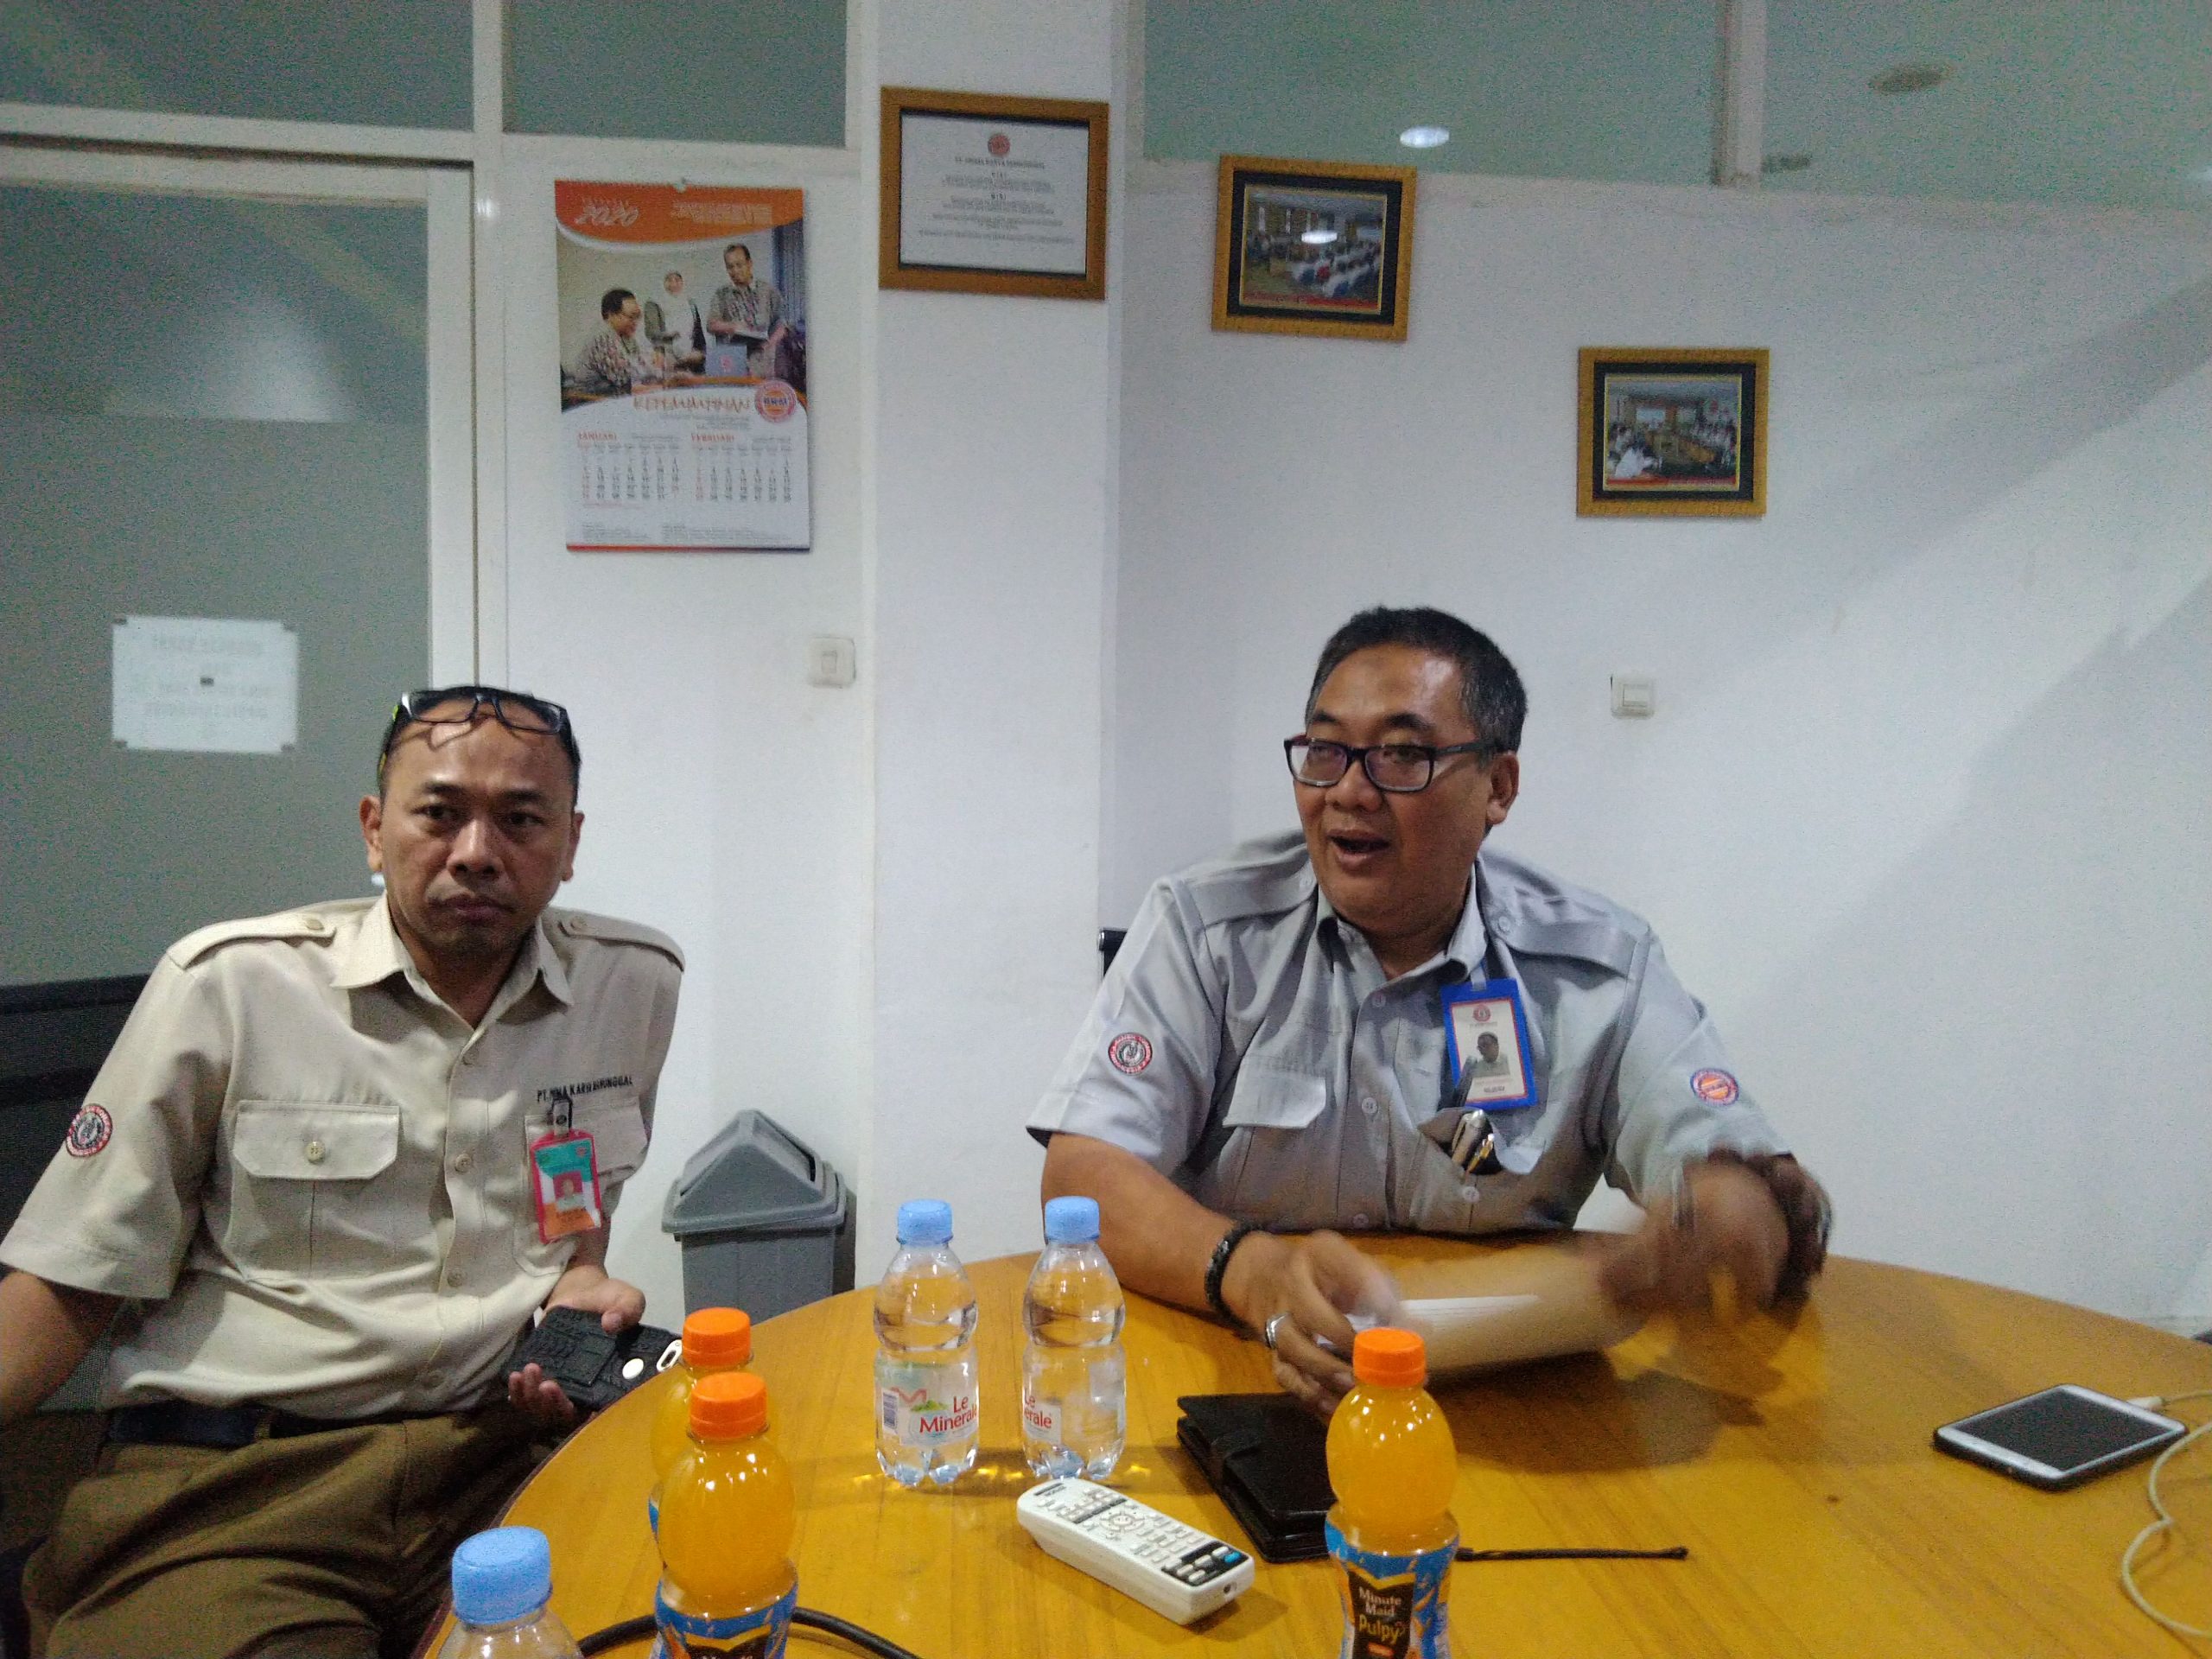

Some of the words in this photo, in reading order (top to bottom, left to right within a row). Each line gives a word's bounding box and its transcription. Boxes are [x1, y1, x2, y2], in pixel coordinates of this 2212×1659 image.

[953, 1395, 969, 1414] Le
[1359, 1586, 1402, 1606] Minute
[1366, 1602, 1396, 1618] Maid
[1360, 1614, 1400, 1644] Pulpy
